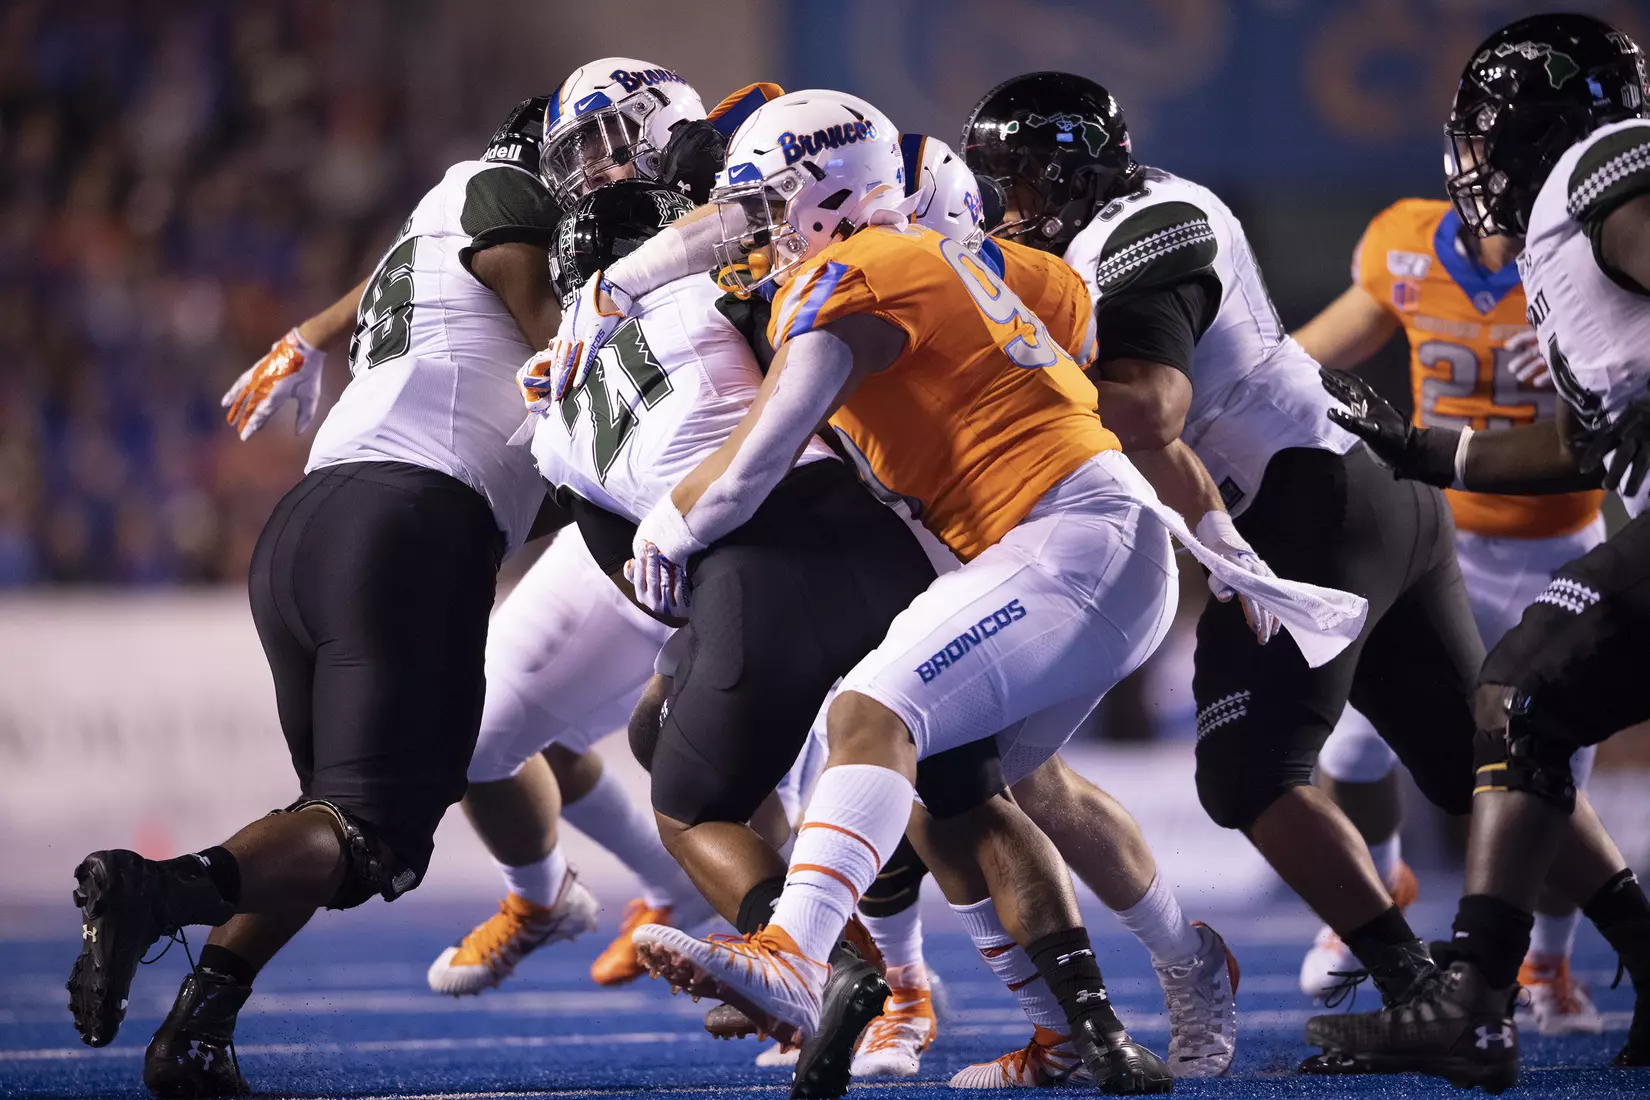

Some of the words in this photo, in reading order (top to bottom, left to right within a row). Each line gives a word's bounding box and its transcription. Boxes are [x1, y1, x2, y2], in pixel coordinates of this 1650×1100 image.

[480, 143, 522, 161] ddell
[776, 119, 879, 166] Broncos
[562, 285, 583, 310] sch
[939, 237, 1073, 369] 9
[583, 328, 606, 375] BRONCOS
[558, 316, 675, 489] 21
[913, 598, 1027, 685] BRONCOS
